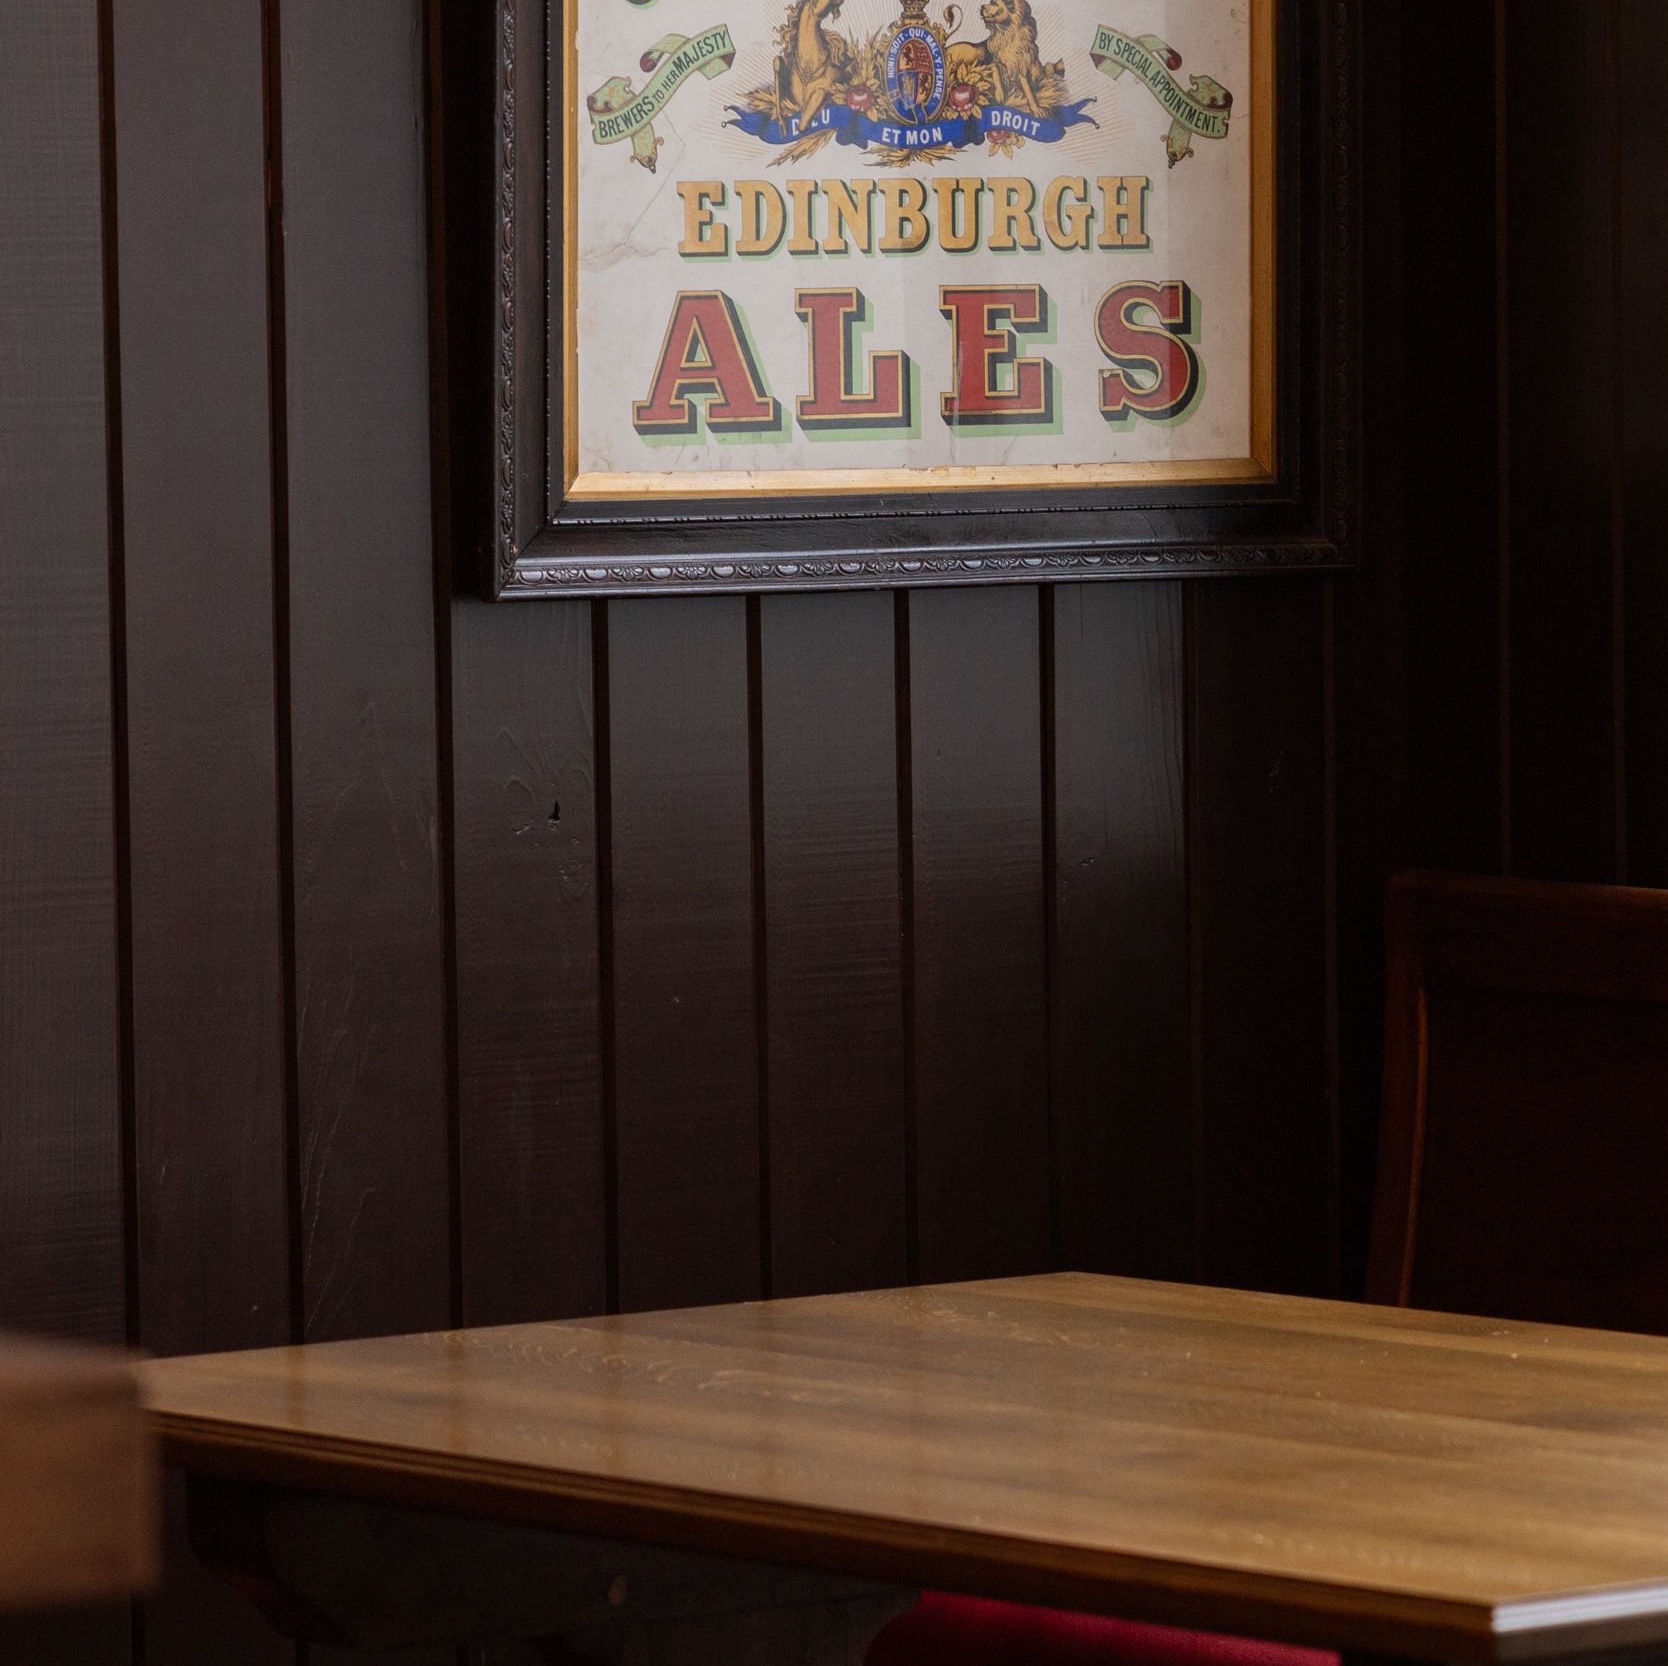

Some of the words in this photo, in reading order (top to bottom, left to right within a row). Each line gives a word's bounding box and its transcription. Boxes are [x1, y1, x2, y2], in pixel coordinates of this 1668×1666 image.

[890, 33, 906, 54] SOIT
[908, 27, 925, 39] QUI
[925, 34, 939, 55] MAL
[598, 95, 656, 139] BREWERS
[652, 88, 665, 104] TO
[661, 70, 679, 92] HER
[672, 30, 728, 76] MAJESTY
[887, 57, 896, 78] HONI
[933, 68, 944, 100] PENSE
[1099, 31, 1114, 52] BY
[1113, 38, 1153, 78] SPECIAL
[1149, 70, 1221, 134] APPOINTMENT.
[882, 127, 900, 144] ET
[905, 127, 943, 146] MON
[991, 110, 1040, 135] DROIT
[676, 175, 1152, 257] EDINBURGH
[632, 280, 1199, 434] ALES
